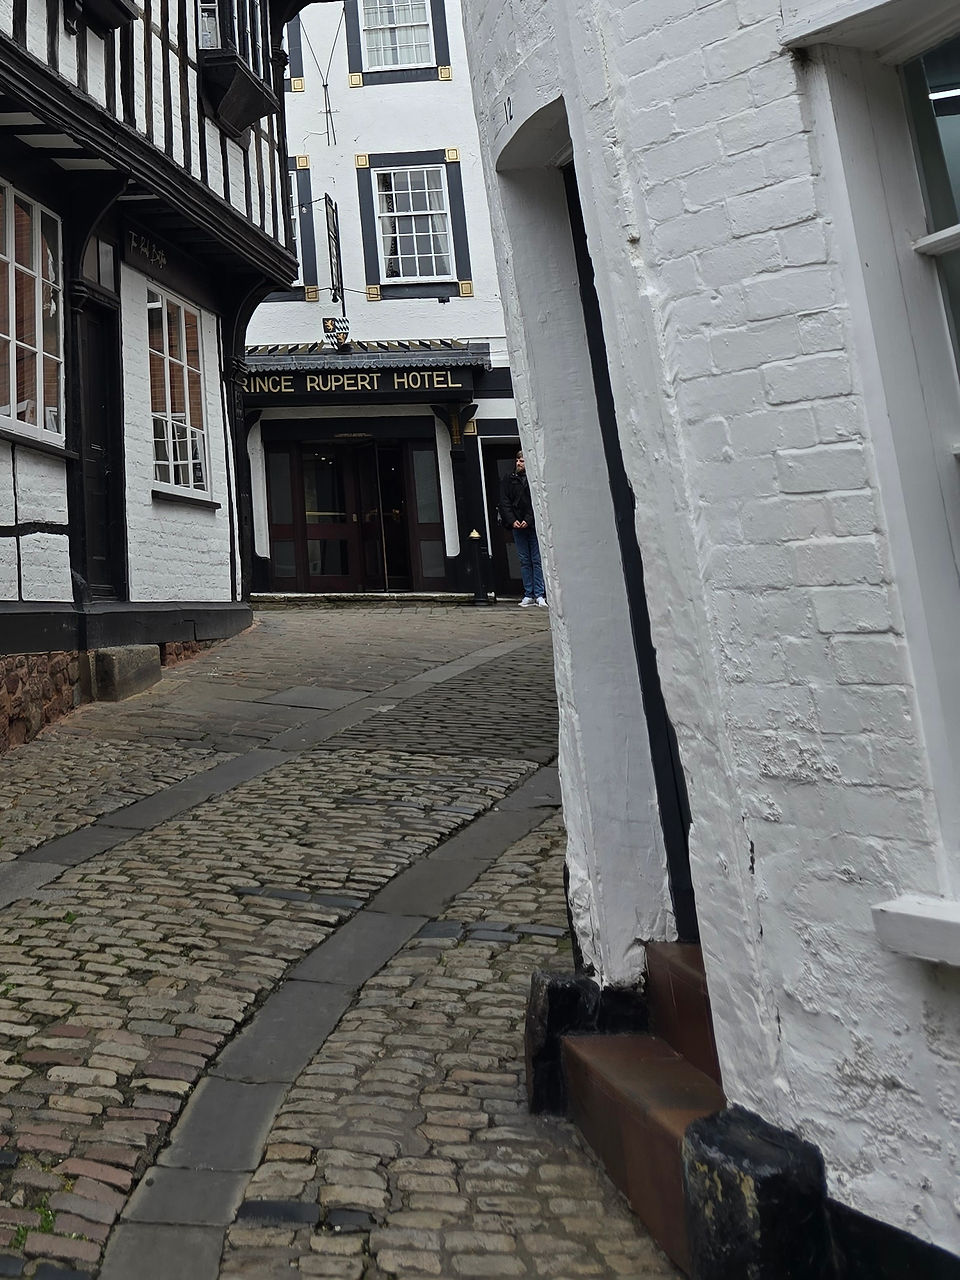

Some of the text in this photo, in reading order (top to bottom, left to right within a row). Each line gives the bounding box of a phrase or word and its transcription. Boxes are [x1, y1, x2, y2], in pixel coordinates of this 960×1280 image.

[242, 370, 463, 393] RINCE RUPERT HOTEL
